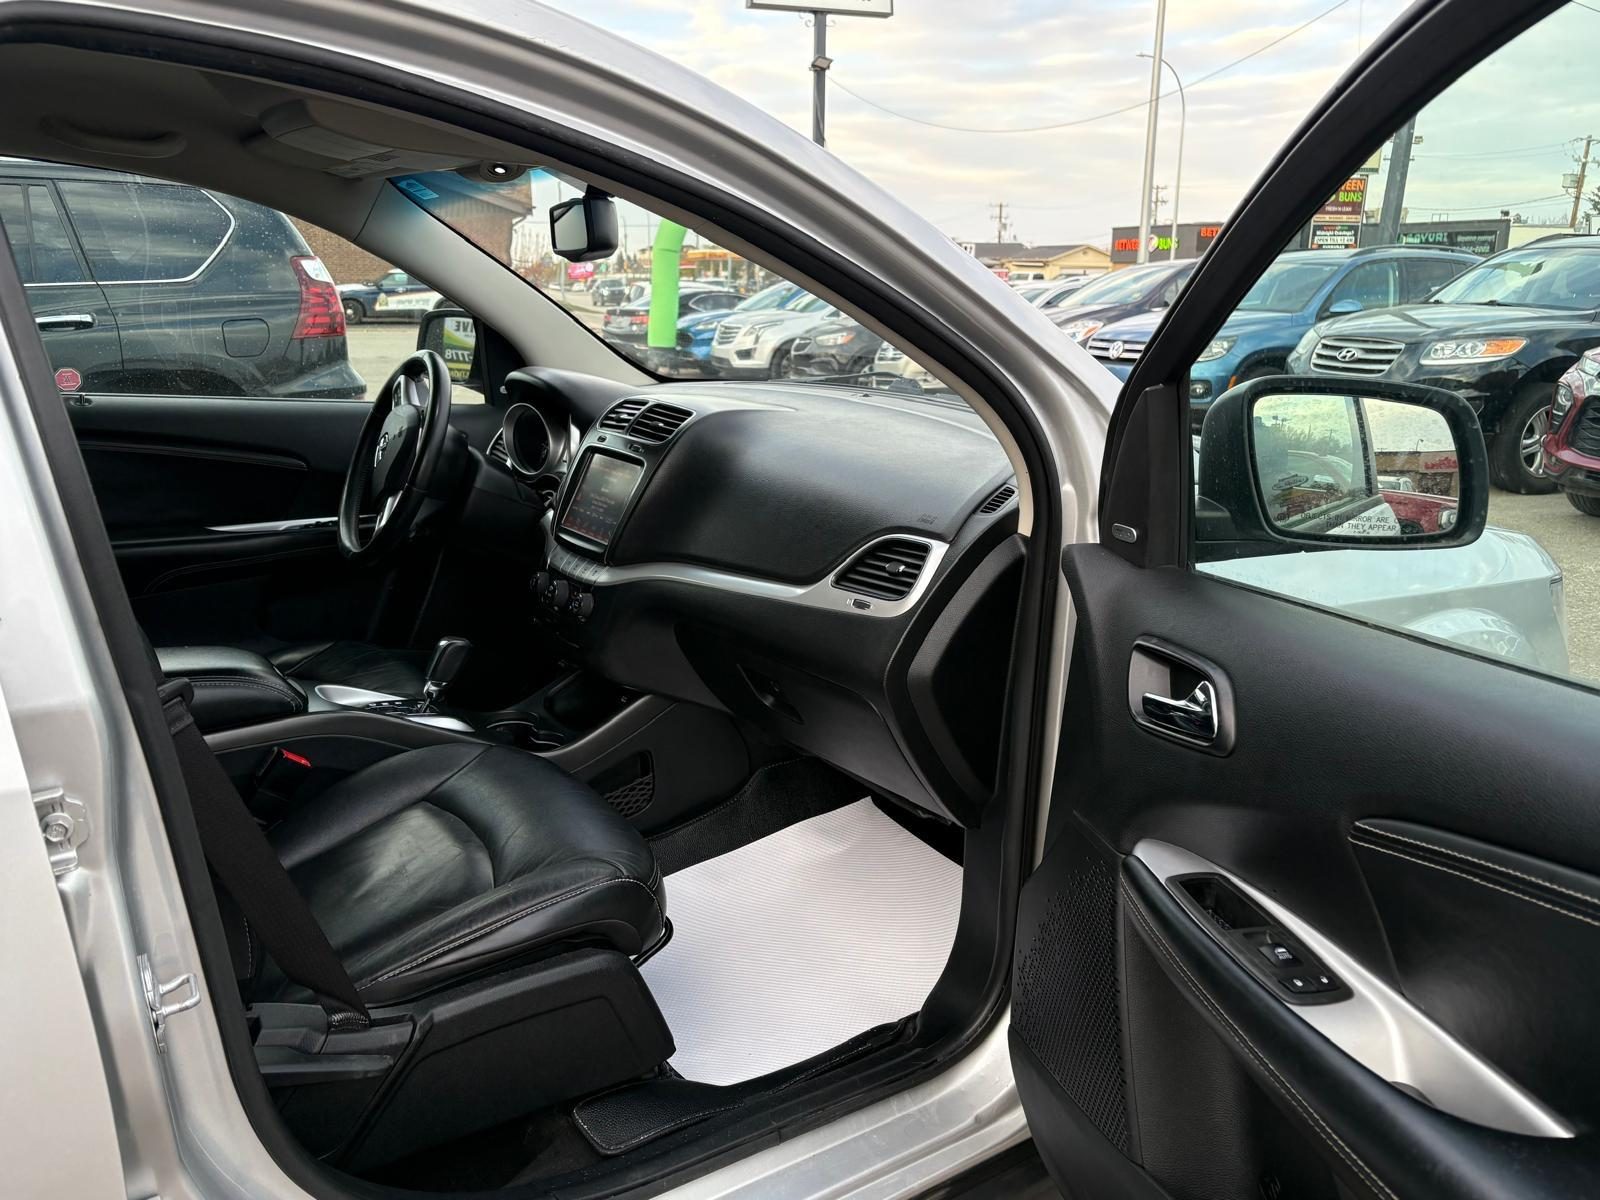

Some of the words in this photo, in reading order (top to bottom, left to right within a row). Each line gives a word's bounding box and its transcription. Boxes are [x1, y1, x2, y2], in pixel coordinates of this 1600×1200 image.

[1339, 191, 1362, 202] BUNS
[1375, 516, 1390, 524] ARE
[1347, 522, 1366, 530] THEY
[1368, 524, 1397, 532] APPEAR
